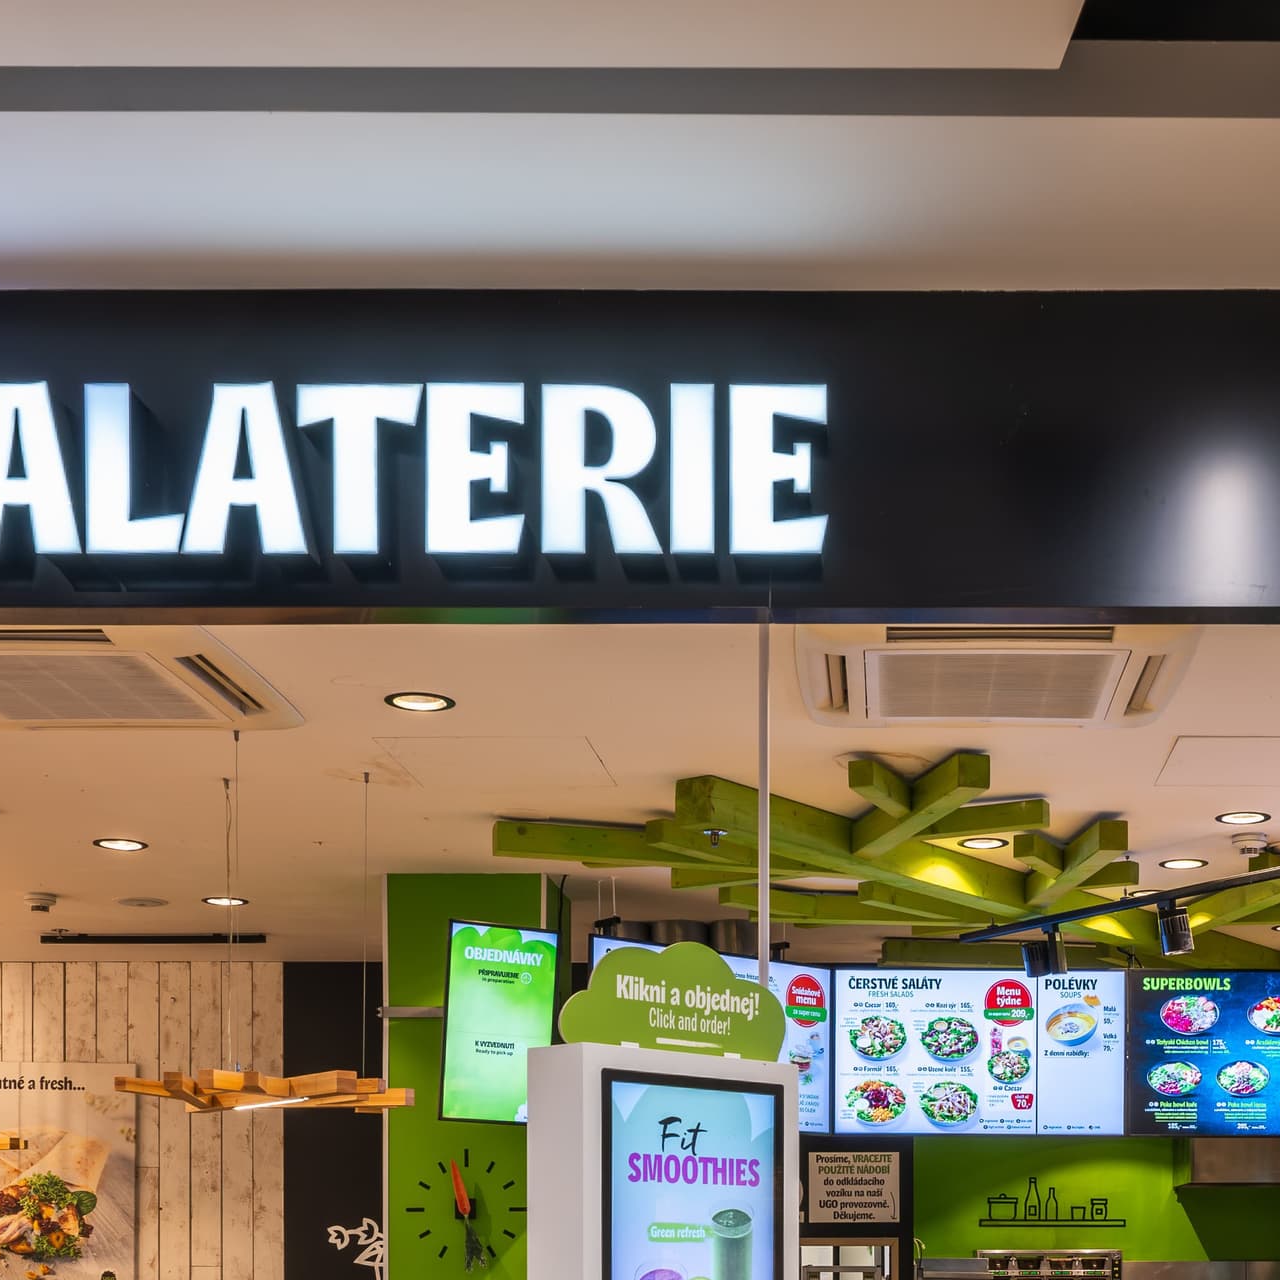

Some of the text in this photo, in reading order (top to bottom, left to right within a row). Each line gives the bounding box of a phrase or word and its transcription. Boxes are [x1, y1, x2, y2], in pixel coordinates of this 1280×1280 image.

[464, 946, 544, 968] OBJEDNÁVKY
[848, 976, 942, 990] ČERSTVÉ SALÁTY
[1045, 977, 1097, 990] POLÉVKY
[1143, 977, 1231, 990] SUPERBOWLS
[616, 974, 760, 1021] Klikni a objednej!
[648, 1007, 731, 1036] Click and order!
[28, 1079, 36, 1090] a
[39, 1076, 85, 1092] fresh...
[658, 1116, 708, 1156] Fit
[816, 1154, 893, 1165] Prosíme, VRACEJTE
[628, 1153, 760, 1187] SMOOTHIES
[818, 1165, 890, 1174] POUŽITÉ NÁDOBÍ
[823, 1177, 885, 1186] do odkládacího
[826, 1188, 852, 1197] vozíku
[866, 1188, 883, 1197] naší
[819, 1200, 890, 1210] UGO provozovně.
[833, 1211, 875, 1221] Děkujeme.
[650, 1225, 675, 1239] Green
